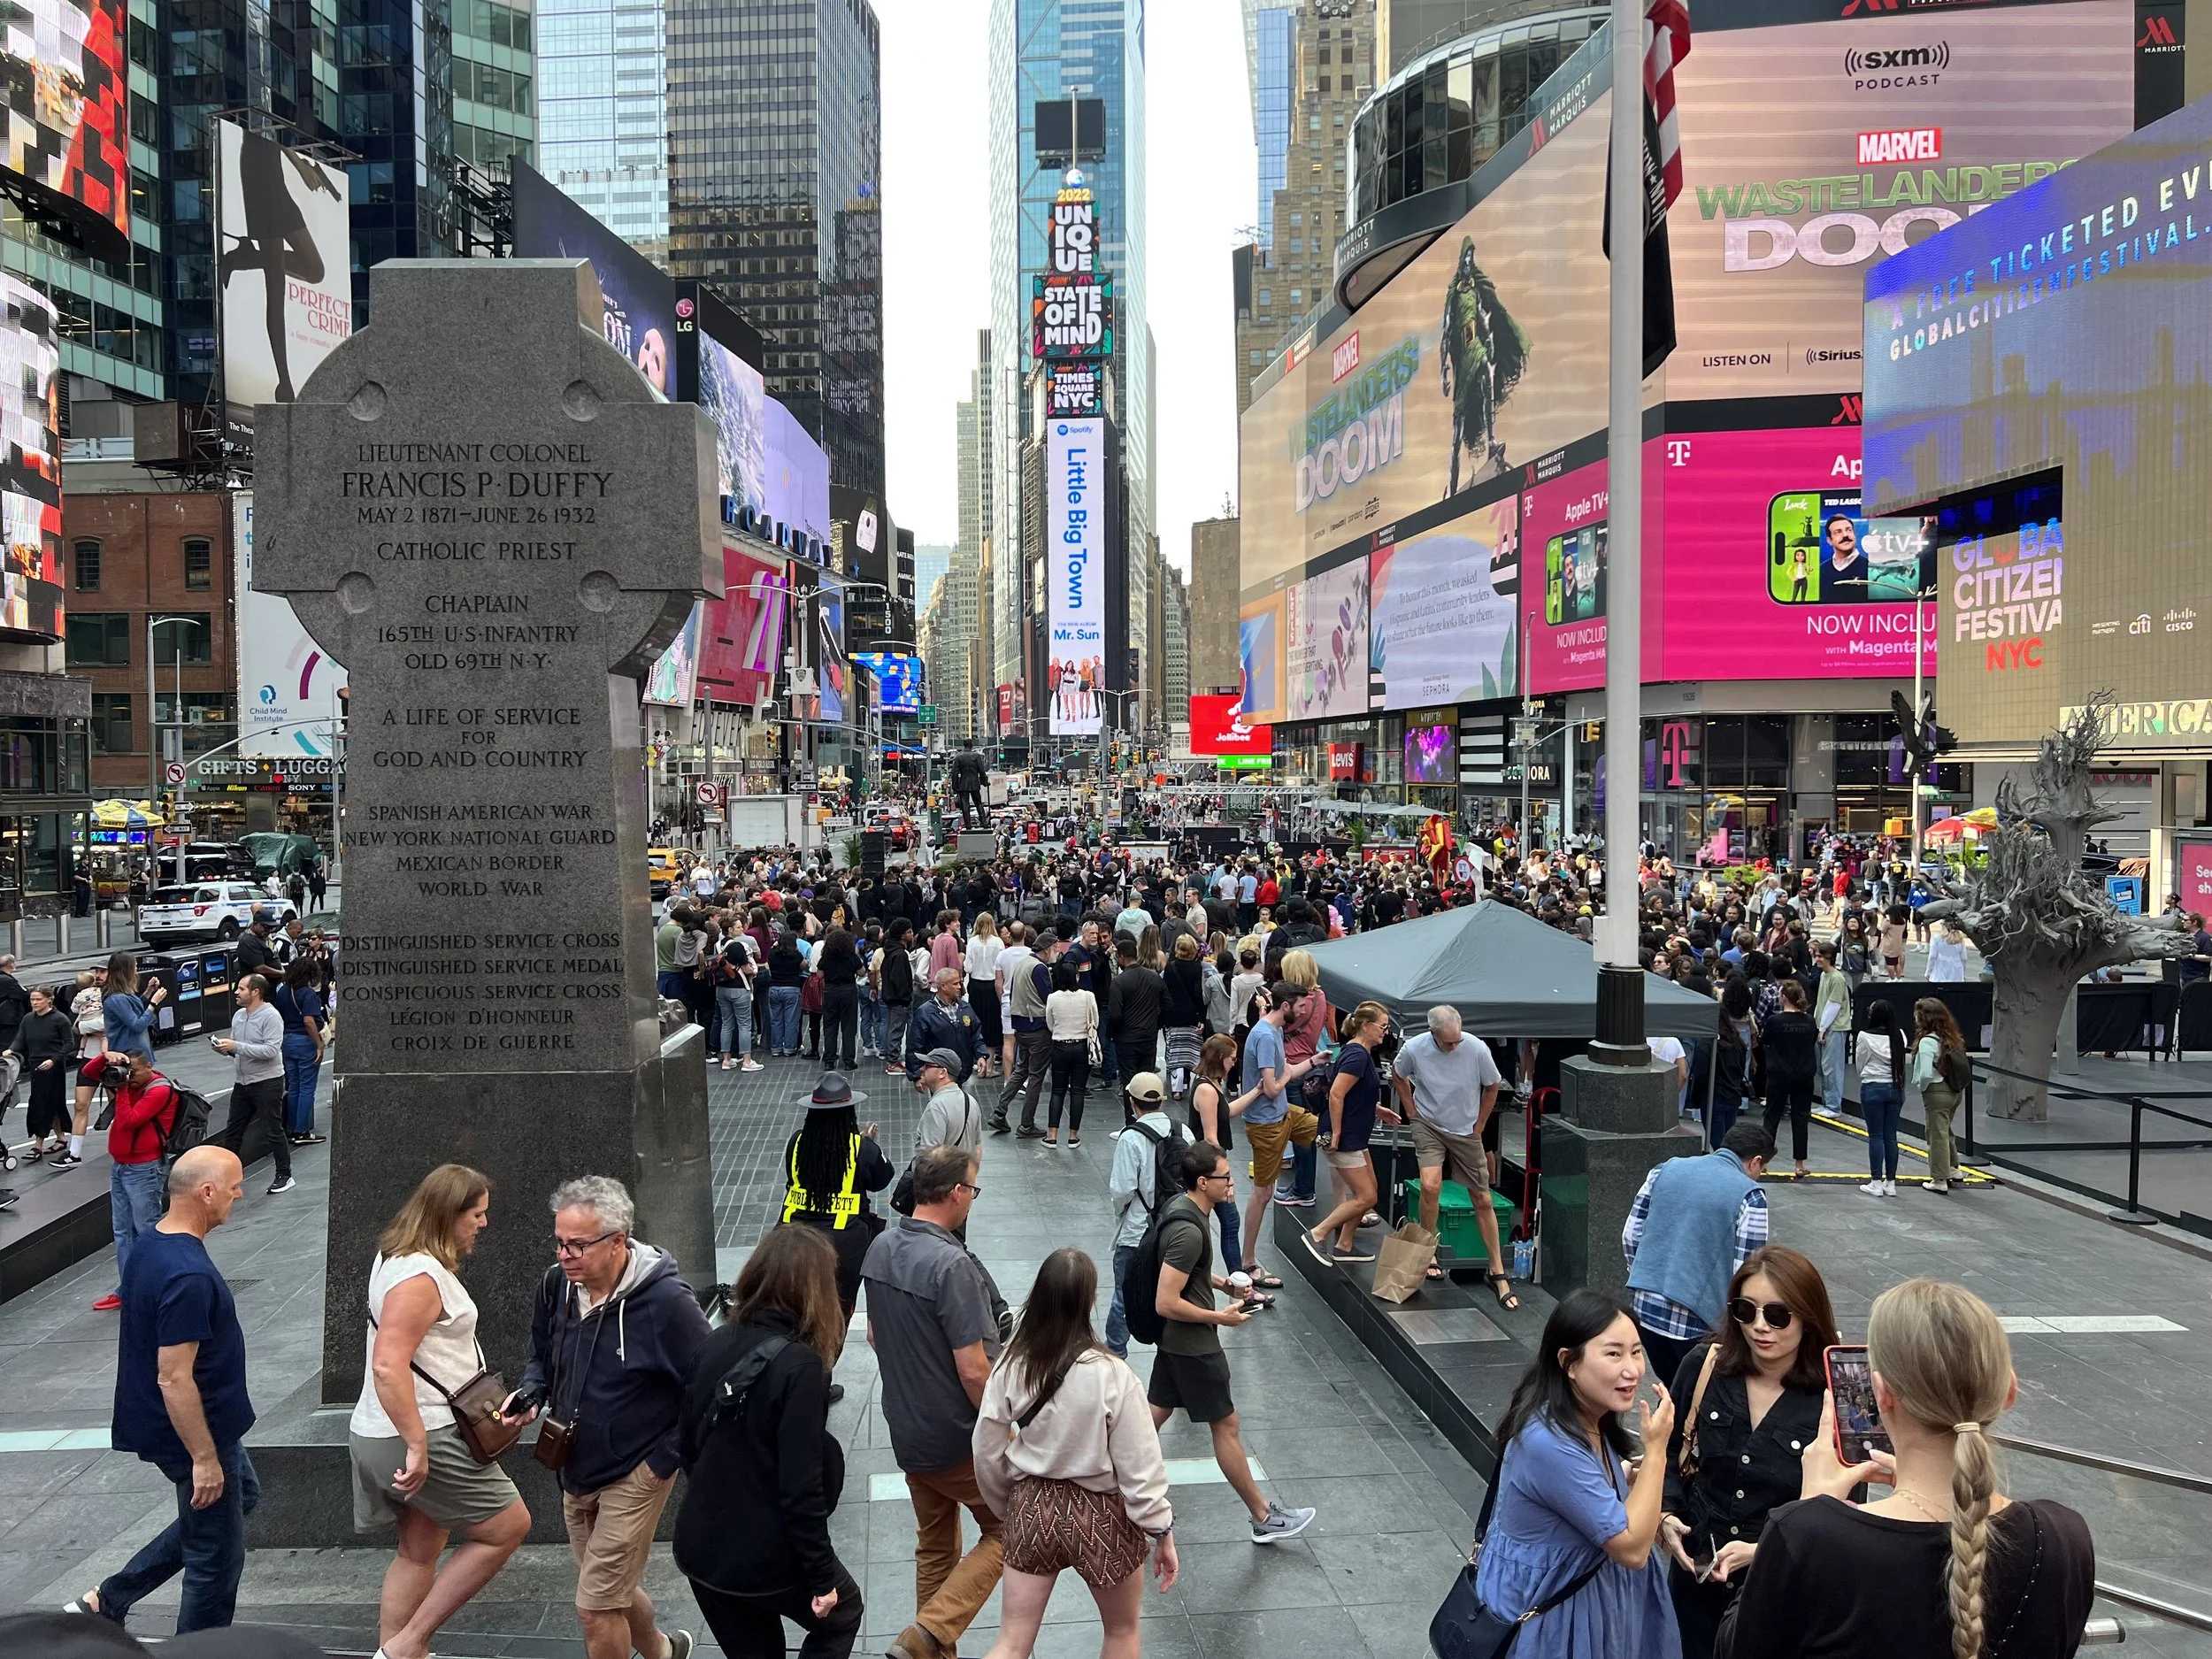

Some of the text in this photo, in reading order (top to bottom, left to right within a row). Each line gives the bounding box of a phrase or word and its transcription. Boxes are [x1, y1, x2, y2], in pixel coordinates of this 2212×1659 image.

[1855, 74, 1939, 90] PODCAST
[1550, 73, 1592, 119] MARRIOTT
[1549, 96, 1586, 136] MARQUIS
[1859, 130, 1939, 164] MARVEL
[1057, 188, 1091, 202] 2022
[1724, 204, 1992, 273] DOO
[1916, 269, 1976, 319] FREE
[1991, 196, 2139, 283] TICKETED
[288, 282, 350, 319] PERFECT
[1044, 286, 1102, 325] STATE
[1045, 303, 1075, 326] OF
[307, 310, 350, 338] CRIME
[677, 321, 693, 332] LG
[1044, 312, 1102, 345] MIND
[1333, 332, 1358, 382] MARVEL
[1703, 349, 1863, 367] LISTEN ON Sirius
[1054, 373, 1094, 383] TIMES
[1054, 383, 1094, 394] SQUARE
[1054, 393, 1094, 409] NYC
[228, 421, 241, 432] The
[1069, 426, 1094, 434] Spotify
[358, 444, 592, 463] LIEUTENANT COLONEL
[1295, 392, 1402, 512] DOOM
[1538, 450, 1565, 469] MARRIOTT
[1538, 463, 1562, 480] MARQUIS
[342, 472, 467, 497] FRANCIS
[508, 472, 615, 497] DUFFY
[357, 508, 399, 524] MAY
[403, 508, 415, 524] 2
[526, 508, 548, 524] 26
[554, 508, 595, 524] 1932
[1565, 497, 1591, 522] Apple
[1064, 448, 1087, 609] Little Big Town
[377, 542, 577, 560] CATHOLIC PRIEST
[1460, 570, 1478, 588] asked
[425, 595, 529, 613] CHAPLAIN
[1436, 594, 1468, 614] community
[1468, 588, 1489, 605] leaders
[1442, 617, 1457, 631] looks
[1458, 613, 1469, 626] like
[1807, 615, 1863, 634] NOW
[2129, 614, 2151, 634] citi
[2166, 621, 2193, 632] cisco
[1054, 629, 1100, 641] Mr. Sun
[1556, 633, 1575, 649] NOW
[1571, 650, 1594, 664] Magenta
[1849, 640, 1916, 657] Magenta
[1985, 637, 2043, 672] NYC
[405, 654, 447, 670] OLD
[1423, 682, 1450, 696] SEPHORA
[381, 709, 581, 725] A LIFE OF SERVICE
[461, 732, 496, 744] FOR
[1216, 733, 1250, 741] Jollibee
[197, 760, 257, 775] GIFTS
[373, 750, 588, 768] GOD AND COUNTRY
[368, 805, 593, 820] SPANISH AMERICAN WAR
[344, 830, 617, 847] NEW YORK NATIONAL GUARD
[396, 856, 565, 871] MEXICAN BORDER
[419, 881, 543, 896] WORLD WAR
[342, 933, 620, 952] DISTINGUISHED SERVICE CROSS
[342, 958, 624, 976] DISTINGUISHED SERVICE MEDAL
[342, 984, 620, 1001] CONSPICUOUS SERVICE CROSS
[469, 1008, 575, 1025] D'HONNEUR
[391, 1034, 574, 1051] CROIX DE GUERRE
